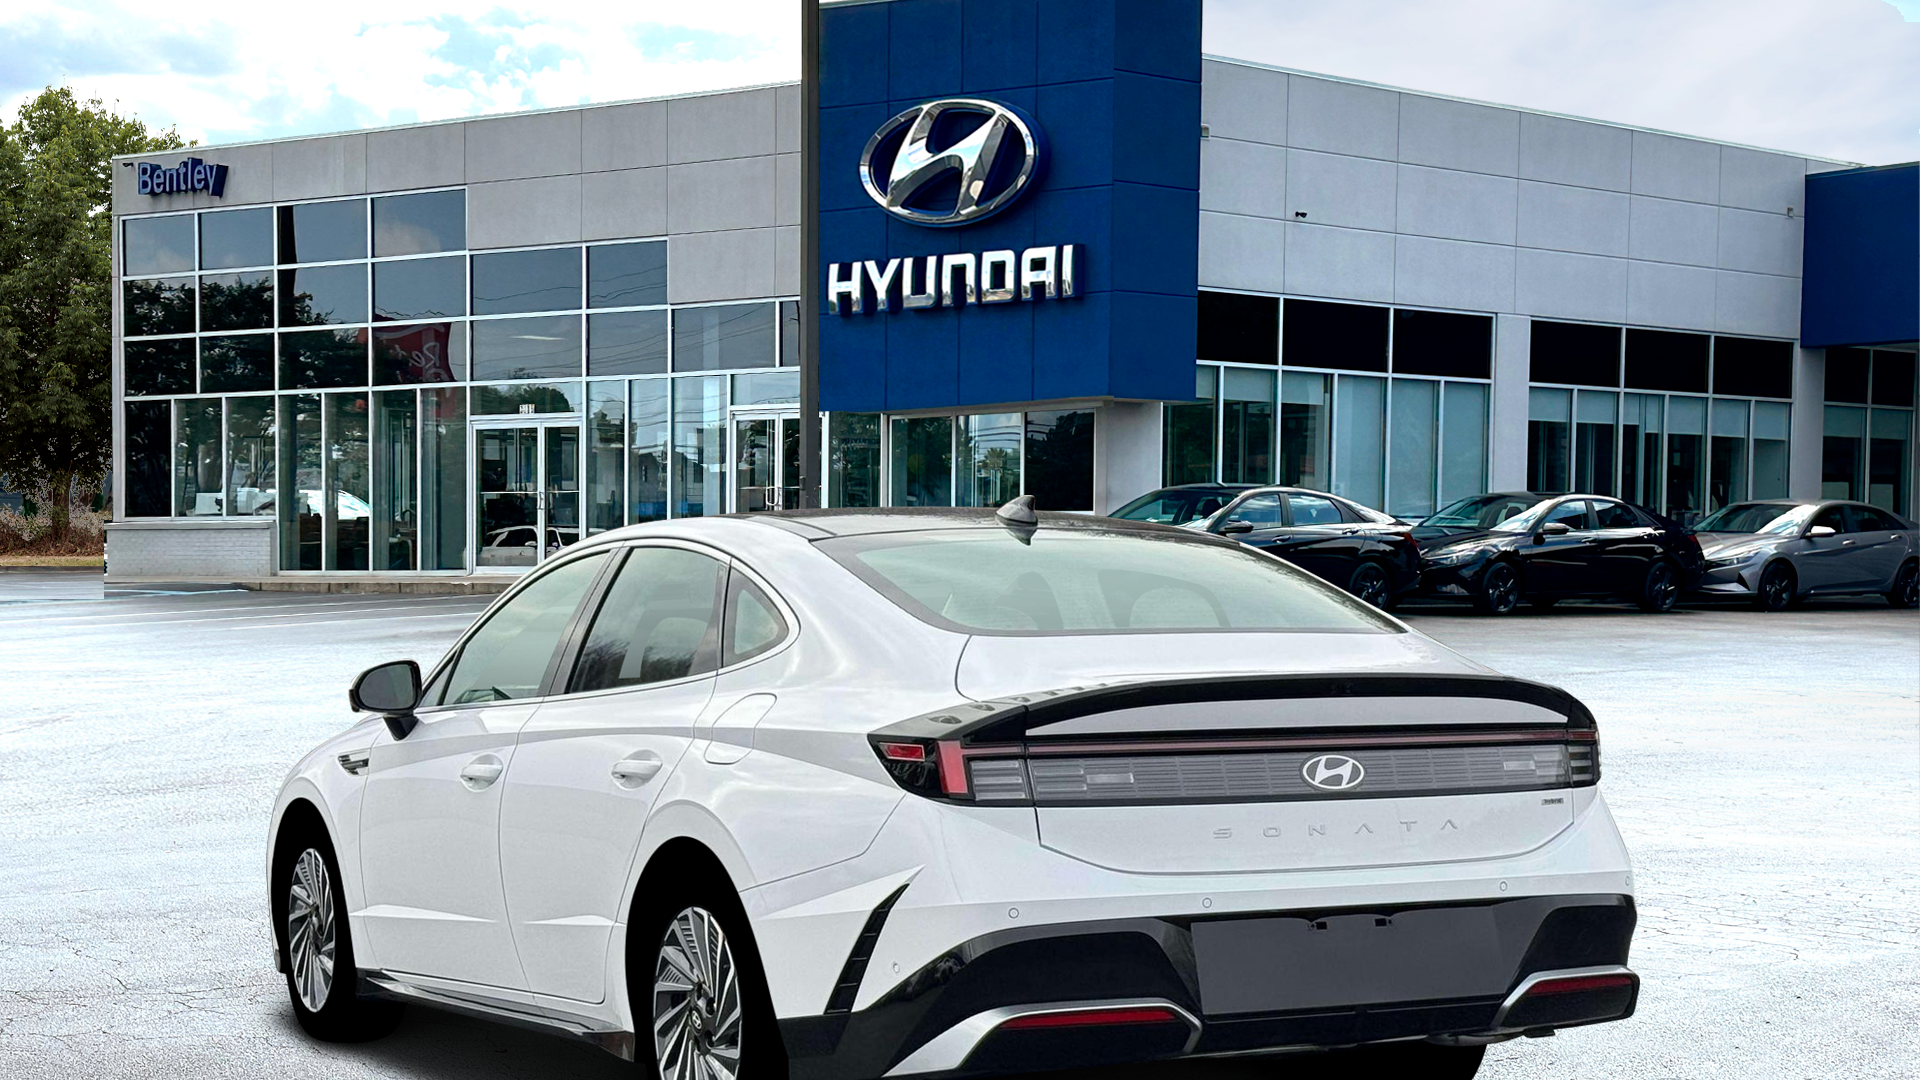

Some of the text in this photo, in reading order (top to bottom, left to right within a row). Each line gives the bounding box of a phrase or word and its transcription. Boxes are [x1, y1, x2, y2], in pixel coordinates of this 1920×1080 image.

[138, 158, 222, 197] Bentley
[827, 244, 1076, 316] HYUNDAI
[1212, 819, 1459, 840] SONATA
